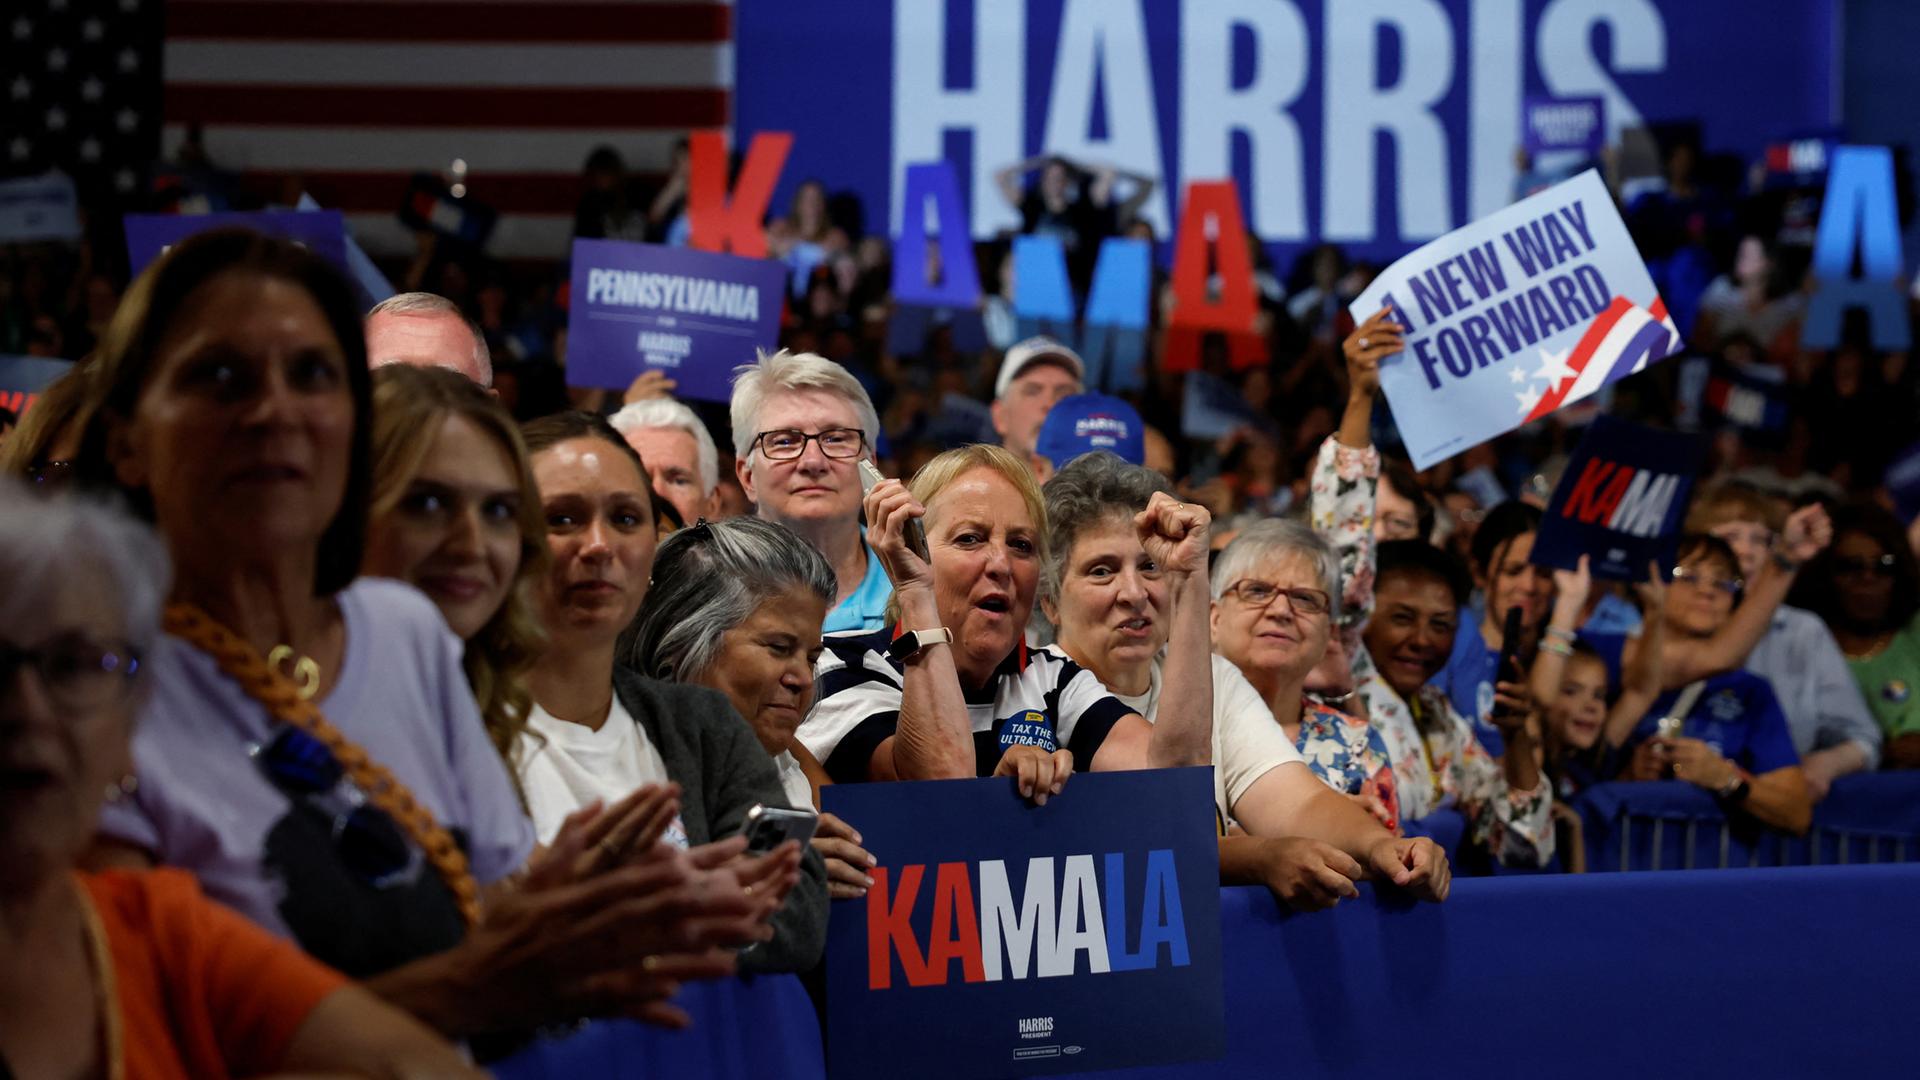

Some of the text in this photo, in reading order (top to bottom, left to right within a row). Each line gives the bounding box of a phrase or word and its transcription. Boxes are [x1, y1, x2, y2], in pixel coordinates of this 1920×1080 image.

[890, 0, 1668, 240] HARRIS
[587, 267, 759, 322] PENNSYLVANIA
[1407, 240, 1508, 326] NEW
[1502, 199, 1597, 280] WAY
[1413, 263, 1612, 390] FORWARD
[1011, 723, 1053, 740] TAX THE
[867, 849, 1191, 990] KAMALA
[1019, 1016, 1054, 1033] HARRIS
[1021, 1031, 1052, 1039] PRESIDENT
